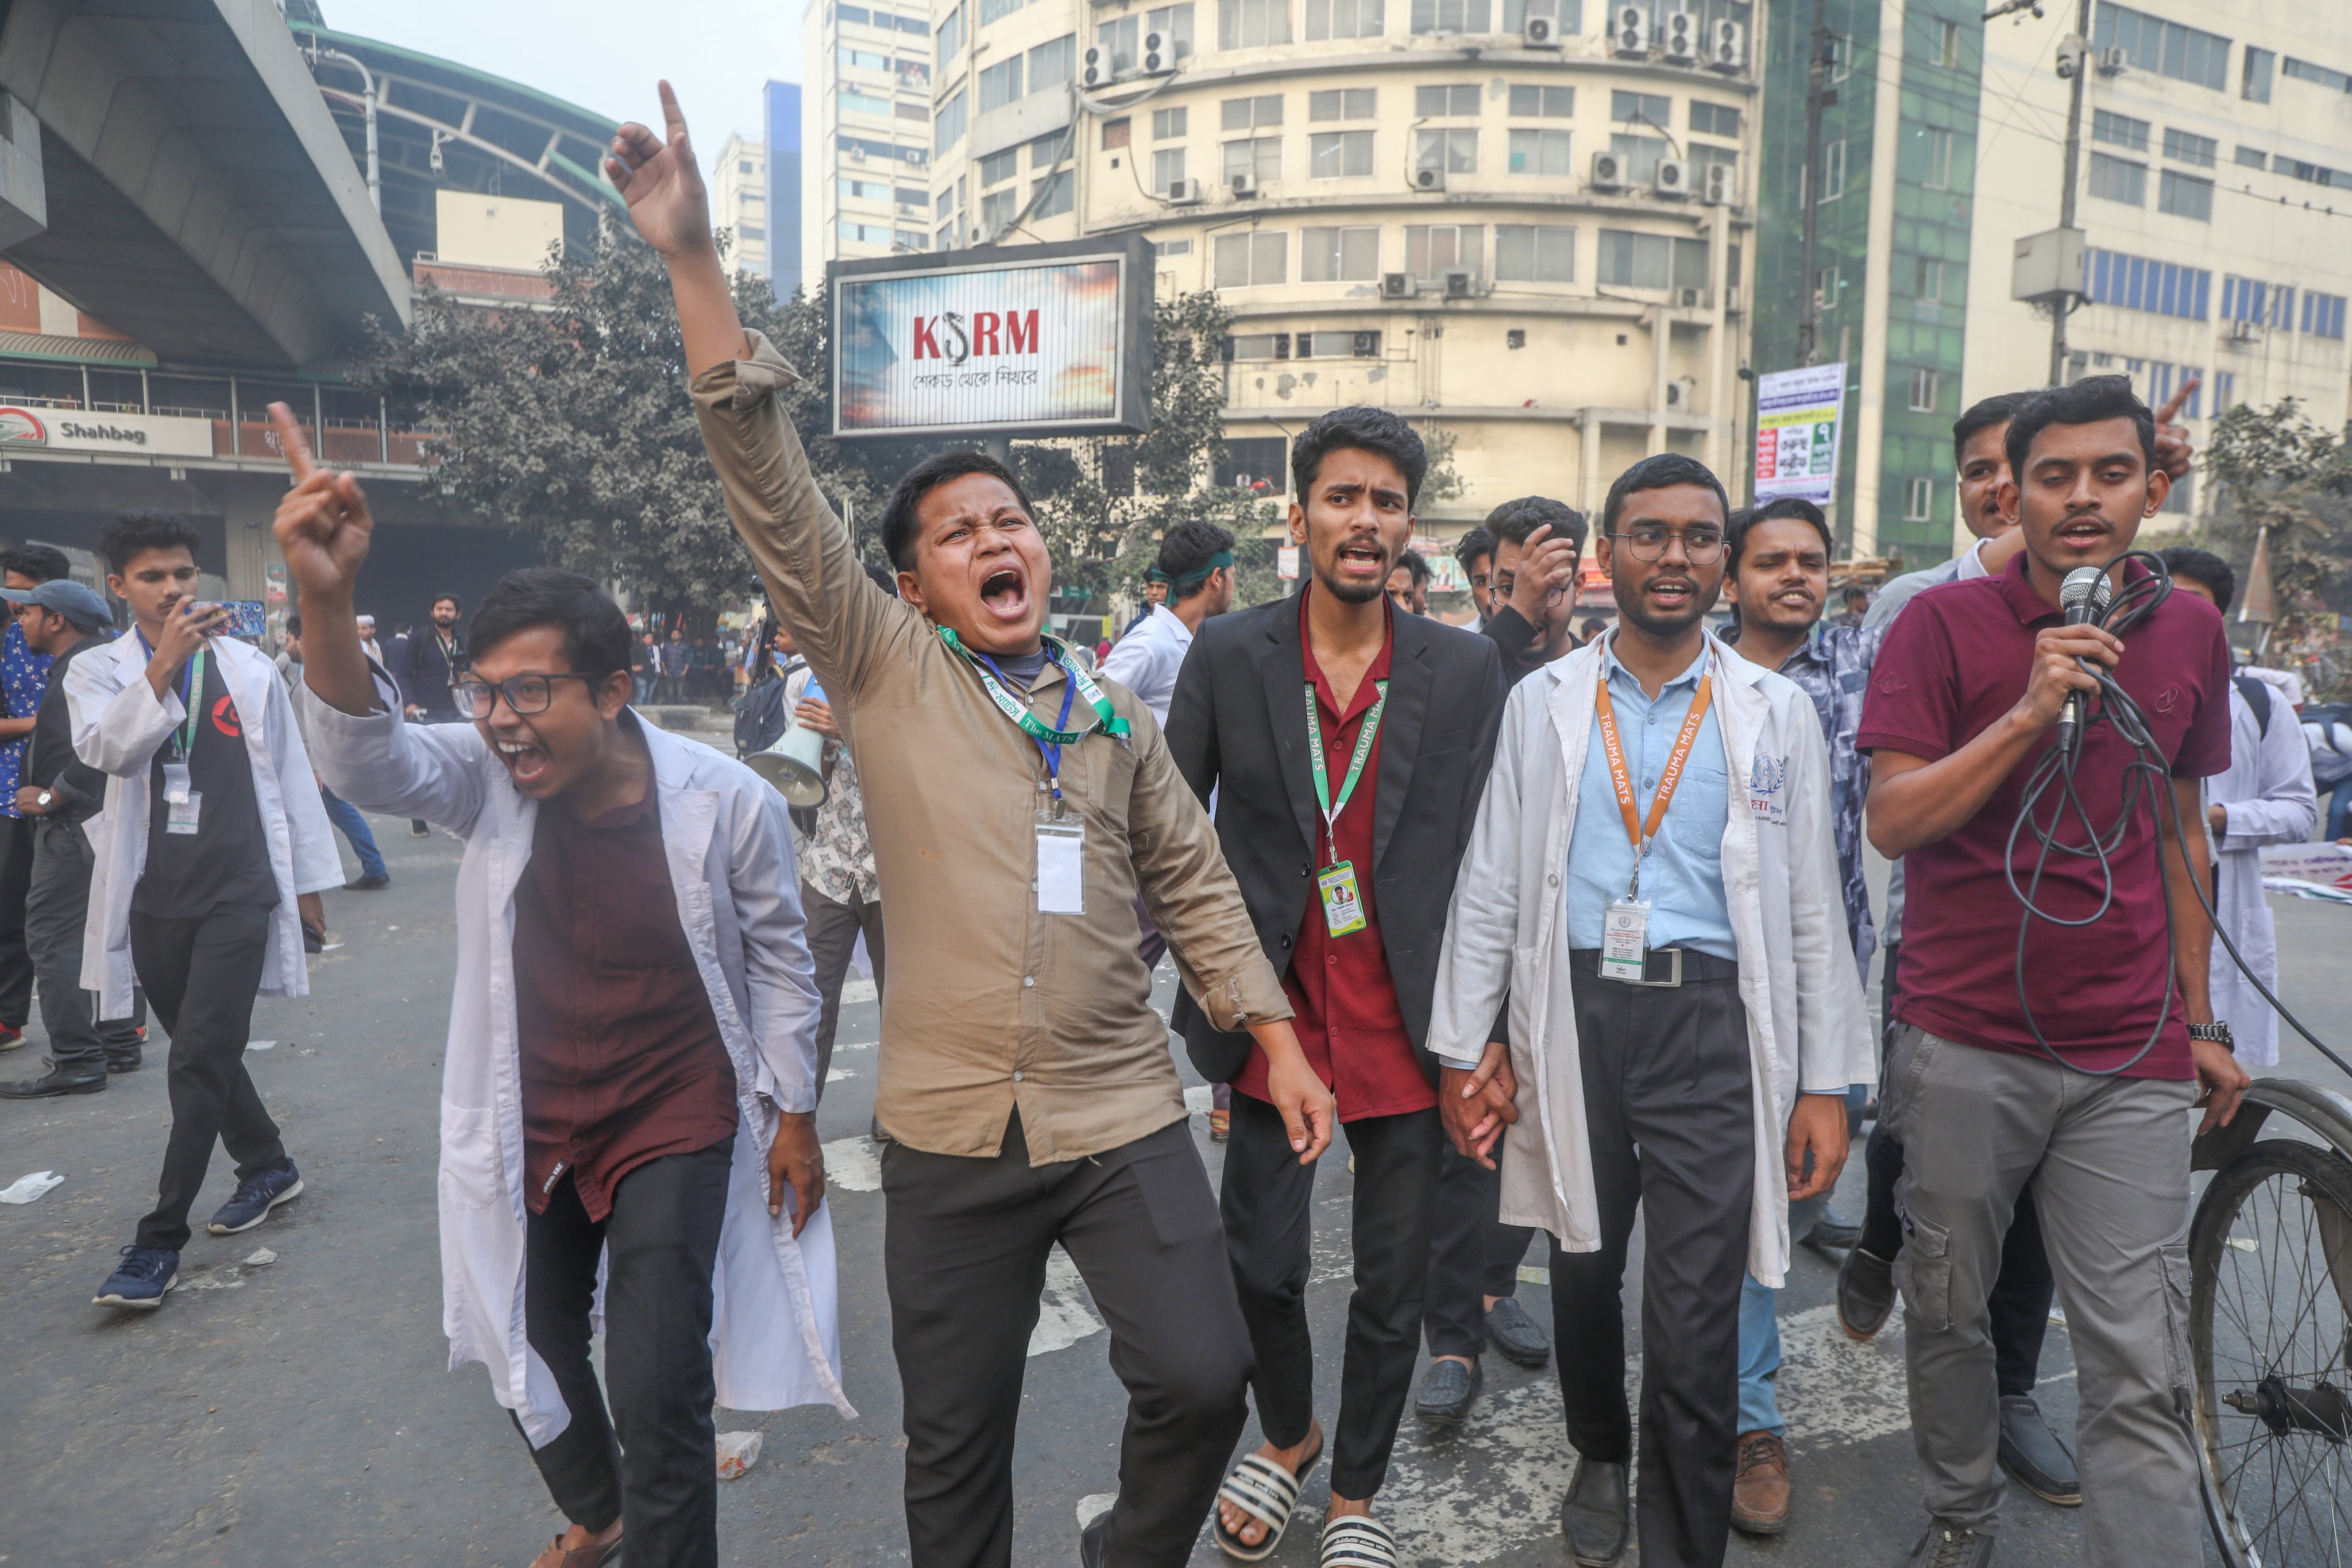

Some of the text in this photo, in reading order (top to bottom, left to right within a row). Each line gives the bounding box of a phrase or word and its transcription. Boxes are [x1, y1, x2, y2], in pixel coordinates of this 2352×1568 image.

[913, 308, 1039, 365] KSRM
[913, 365, 1037, 391] শেকড় থেকে শিখরে
[60, 422, 145, 445] Shahbag
[943, 628, 952, 642] The
[189, 696, 199, 728] TRAUMA
[1025, 718, 1074, 742] The MATS
[1305, 683, 1324, 771] TRAUMA MATS
[1351, 721, 1376, 772] TRAUMA
[1600, 712, 1631, 805] TRAUMA MATS
[1657, 712, 1700, 801] TRAUMA MATS
